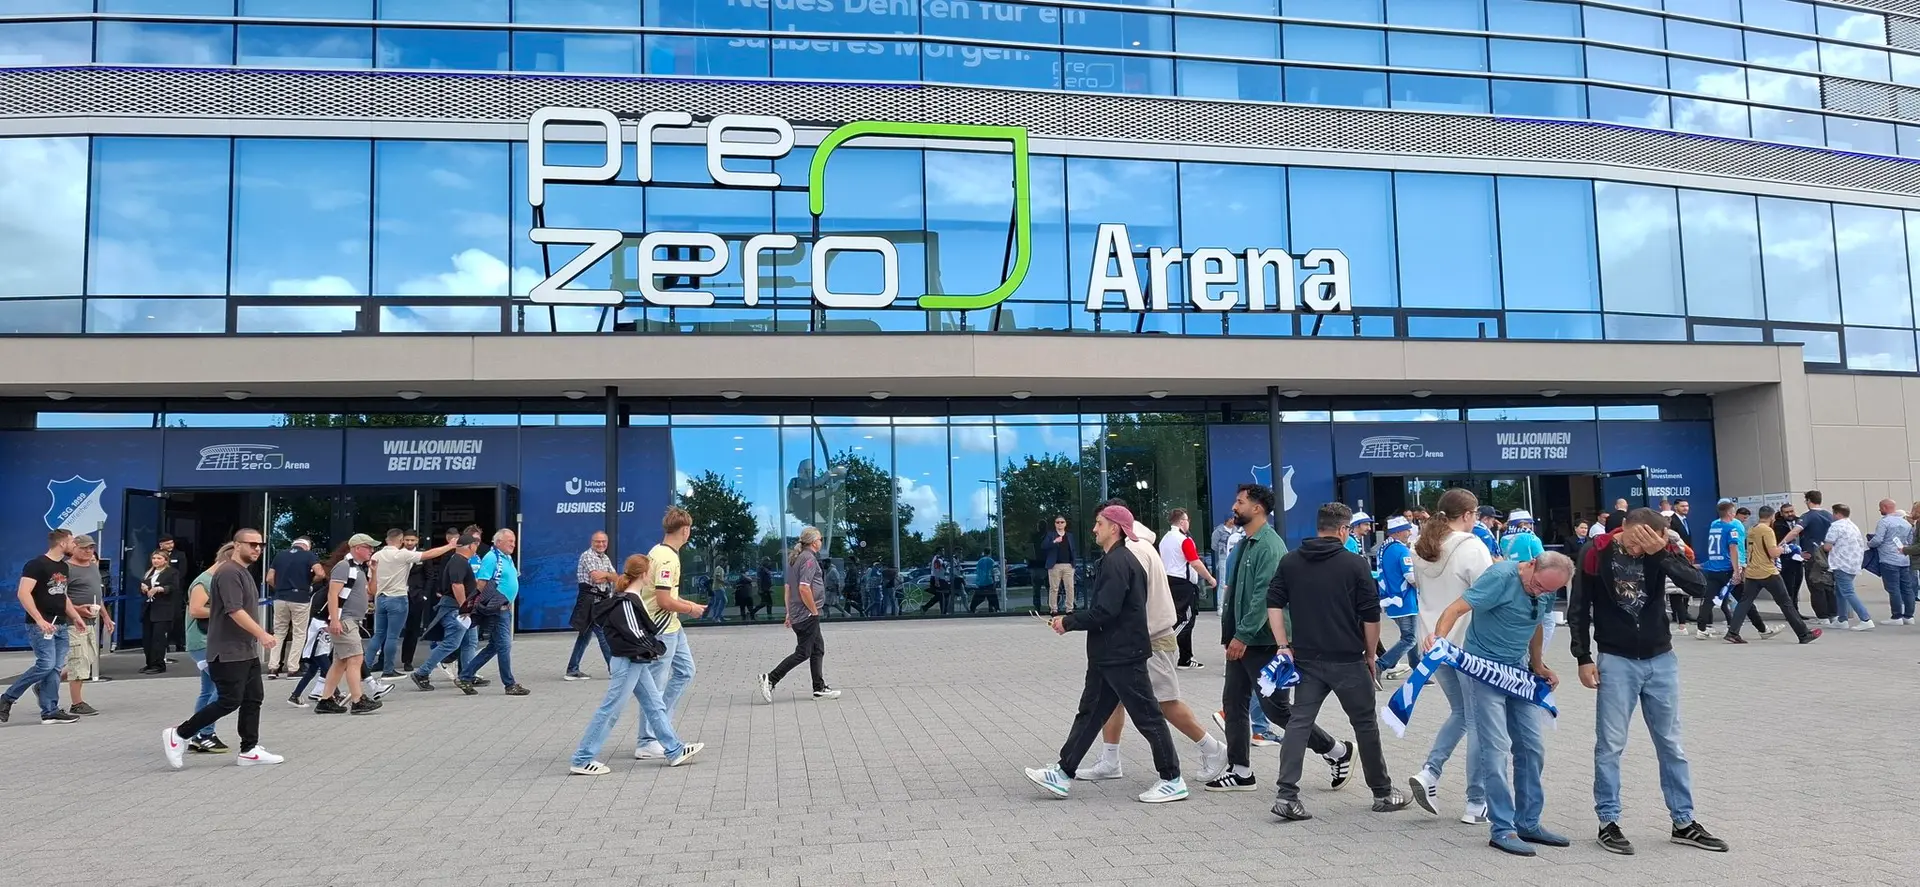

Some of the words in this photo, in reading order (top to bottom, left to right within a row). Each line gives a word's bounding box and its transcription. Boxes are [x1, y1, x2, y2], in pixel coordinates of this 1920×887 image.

[727, 0, 834, 12] eues
[527, 106, 796, 207] pre
[528, 227, 900, 309] zero
[1085, 222, 1352, 313] Arena
[1496, 432, 1571, 445] WILLKOMMEN
[383, 440, 483, 455] WILLKOMMEN
[1392, 443, 1409, 452] pre
[1425, 450, 1444, 458] Arena
[1501, 447, 1519, 459] BEI
[1520, 447, 1541, 459] DER
[1543, 446, 1568, 459] TSG!
[241, 454, 264, 462] pre
[388, 456, 411, 471] BEI
[412, 456, 442, 471] DER
[444, 456, 477, 470] TSG!
[241, 462, 272, 470] zero
[284, 460, 310, 470] Arena
[1630, 486, 1691, 497] BUINESSCLUB
[57, 506, 73, 521] TSG
[555, 501, 635, 514] BUSINESSUB
[1708, 534, 1722, 555] 27
